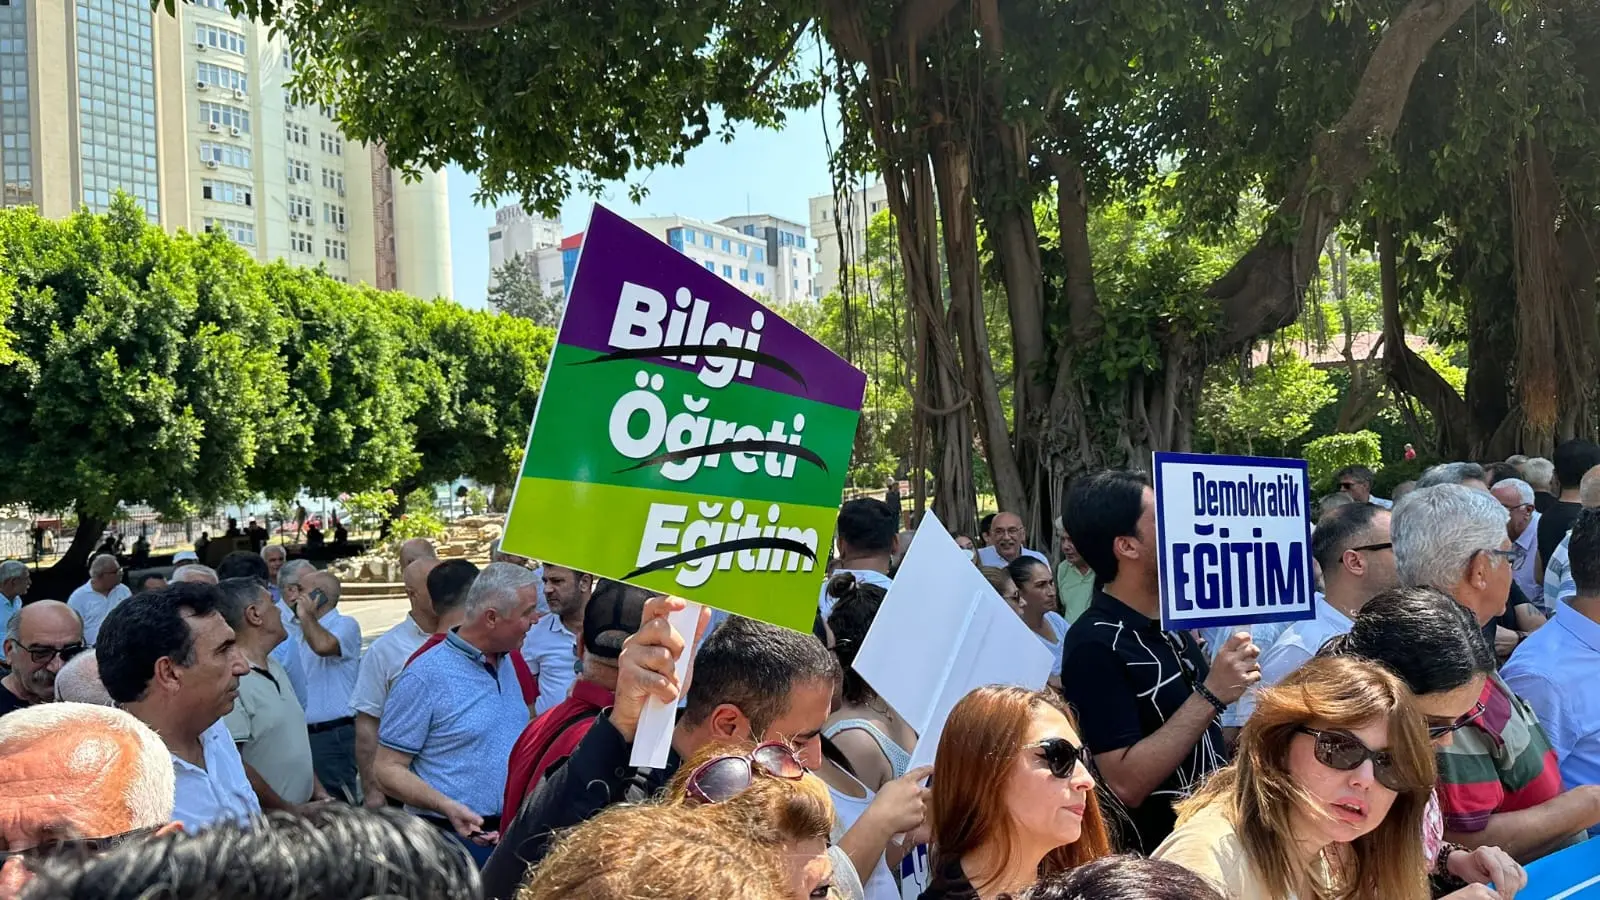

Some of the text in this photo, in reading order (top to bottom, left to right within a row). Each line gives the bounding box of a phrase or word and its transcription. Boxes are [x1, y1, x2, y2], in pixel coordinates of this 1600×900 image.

[608, 281, 765, 388] Bilgi
[608, 370, 805, 481] Öğreti
[1192, 471, 1300, 517] Demokratik
[635, 500, 819, 587] Eğitim
[1172, 523, 1306, 611] EĞİTİM
